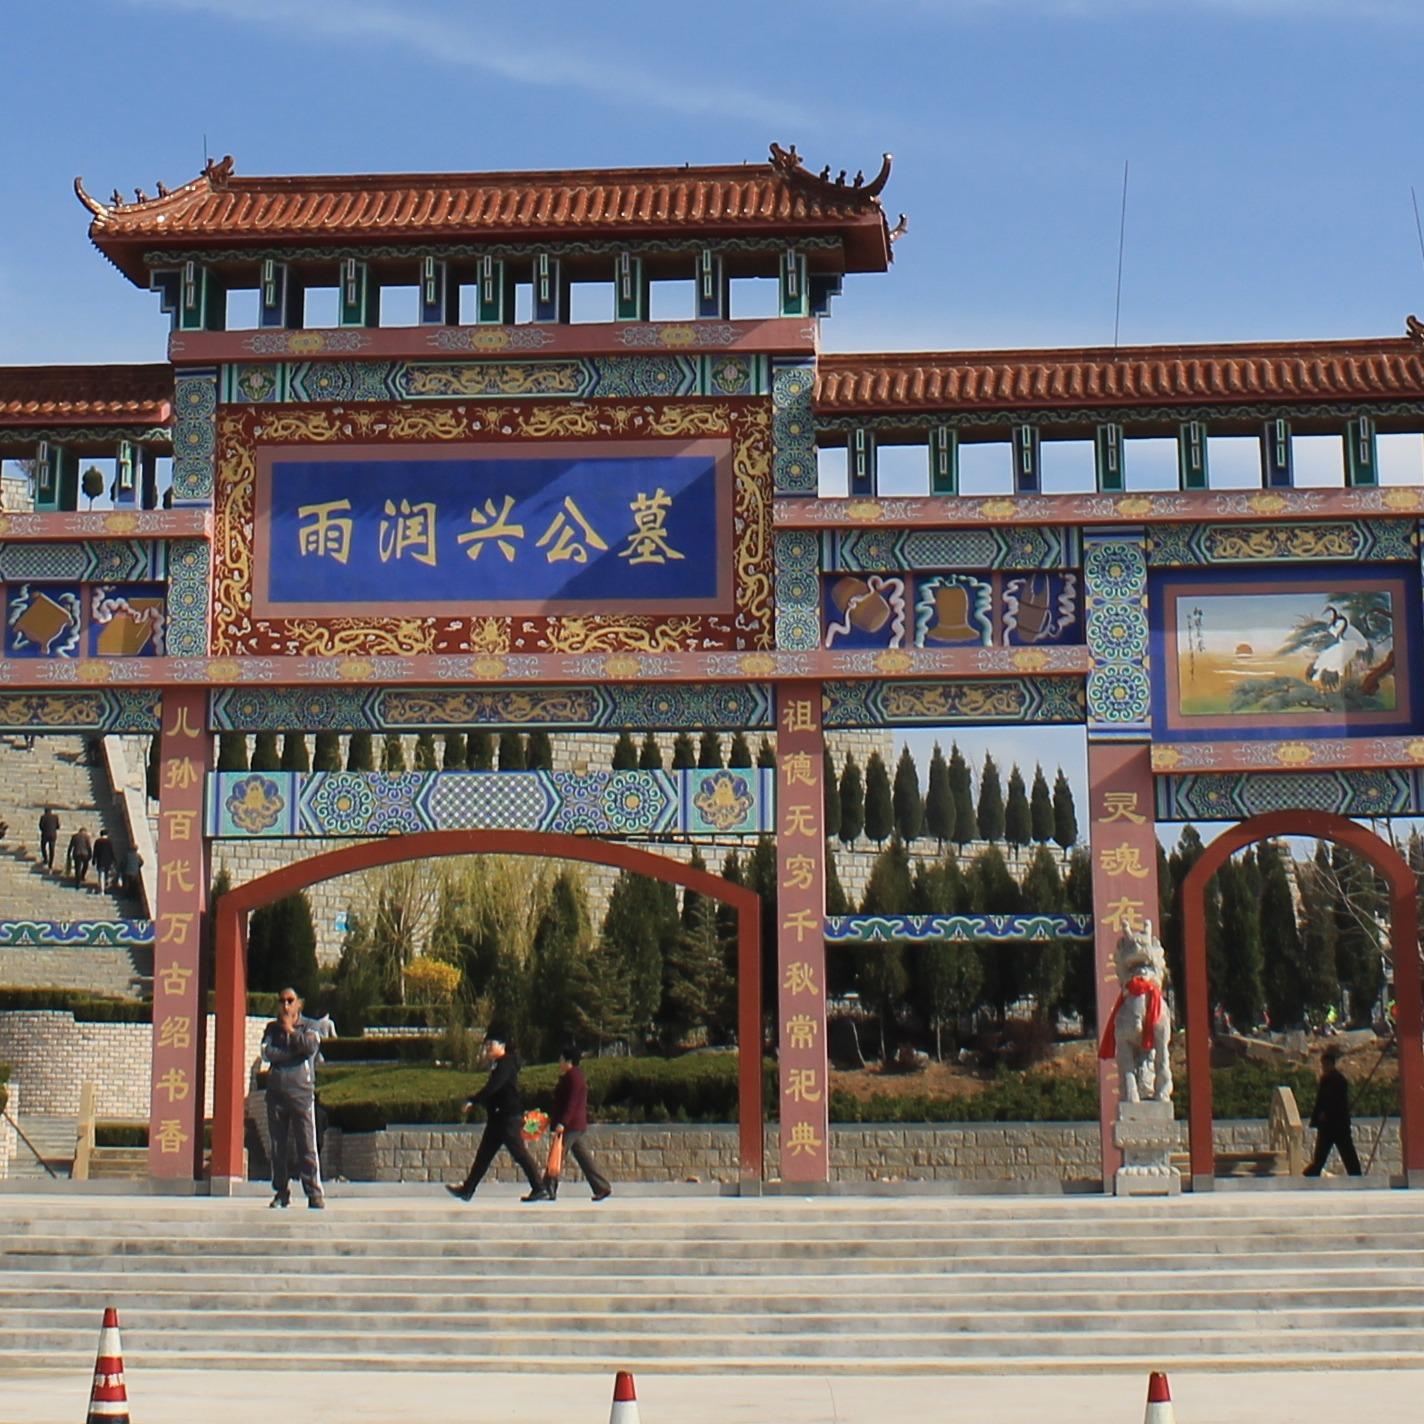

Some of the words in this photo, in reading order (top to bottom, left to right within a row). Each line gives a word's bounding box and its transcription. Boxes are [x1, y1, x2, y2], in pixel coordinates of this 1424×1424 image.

[297, 486, 686, 567] 雨润兴公墓
[154, 706, 201, 1154] 儿孙百代万古绍书香
[781, 700, 823, 1157] 祖德无穷千秋常祀典
